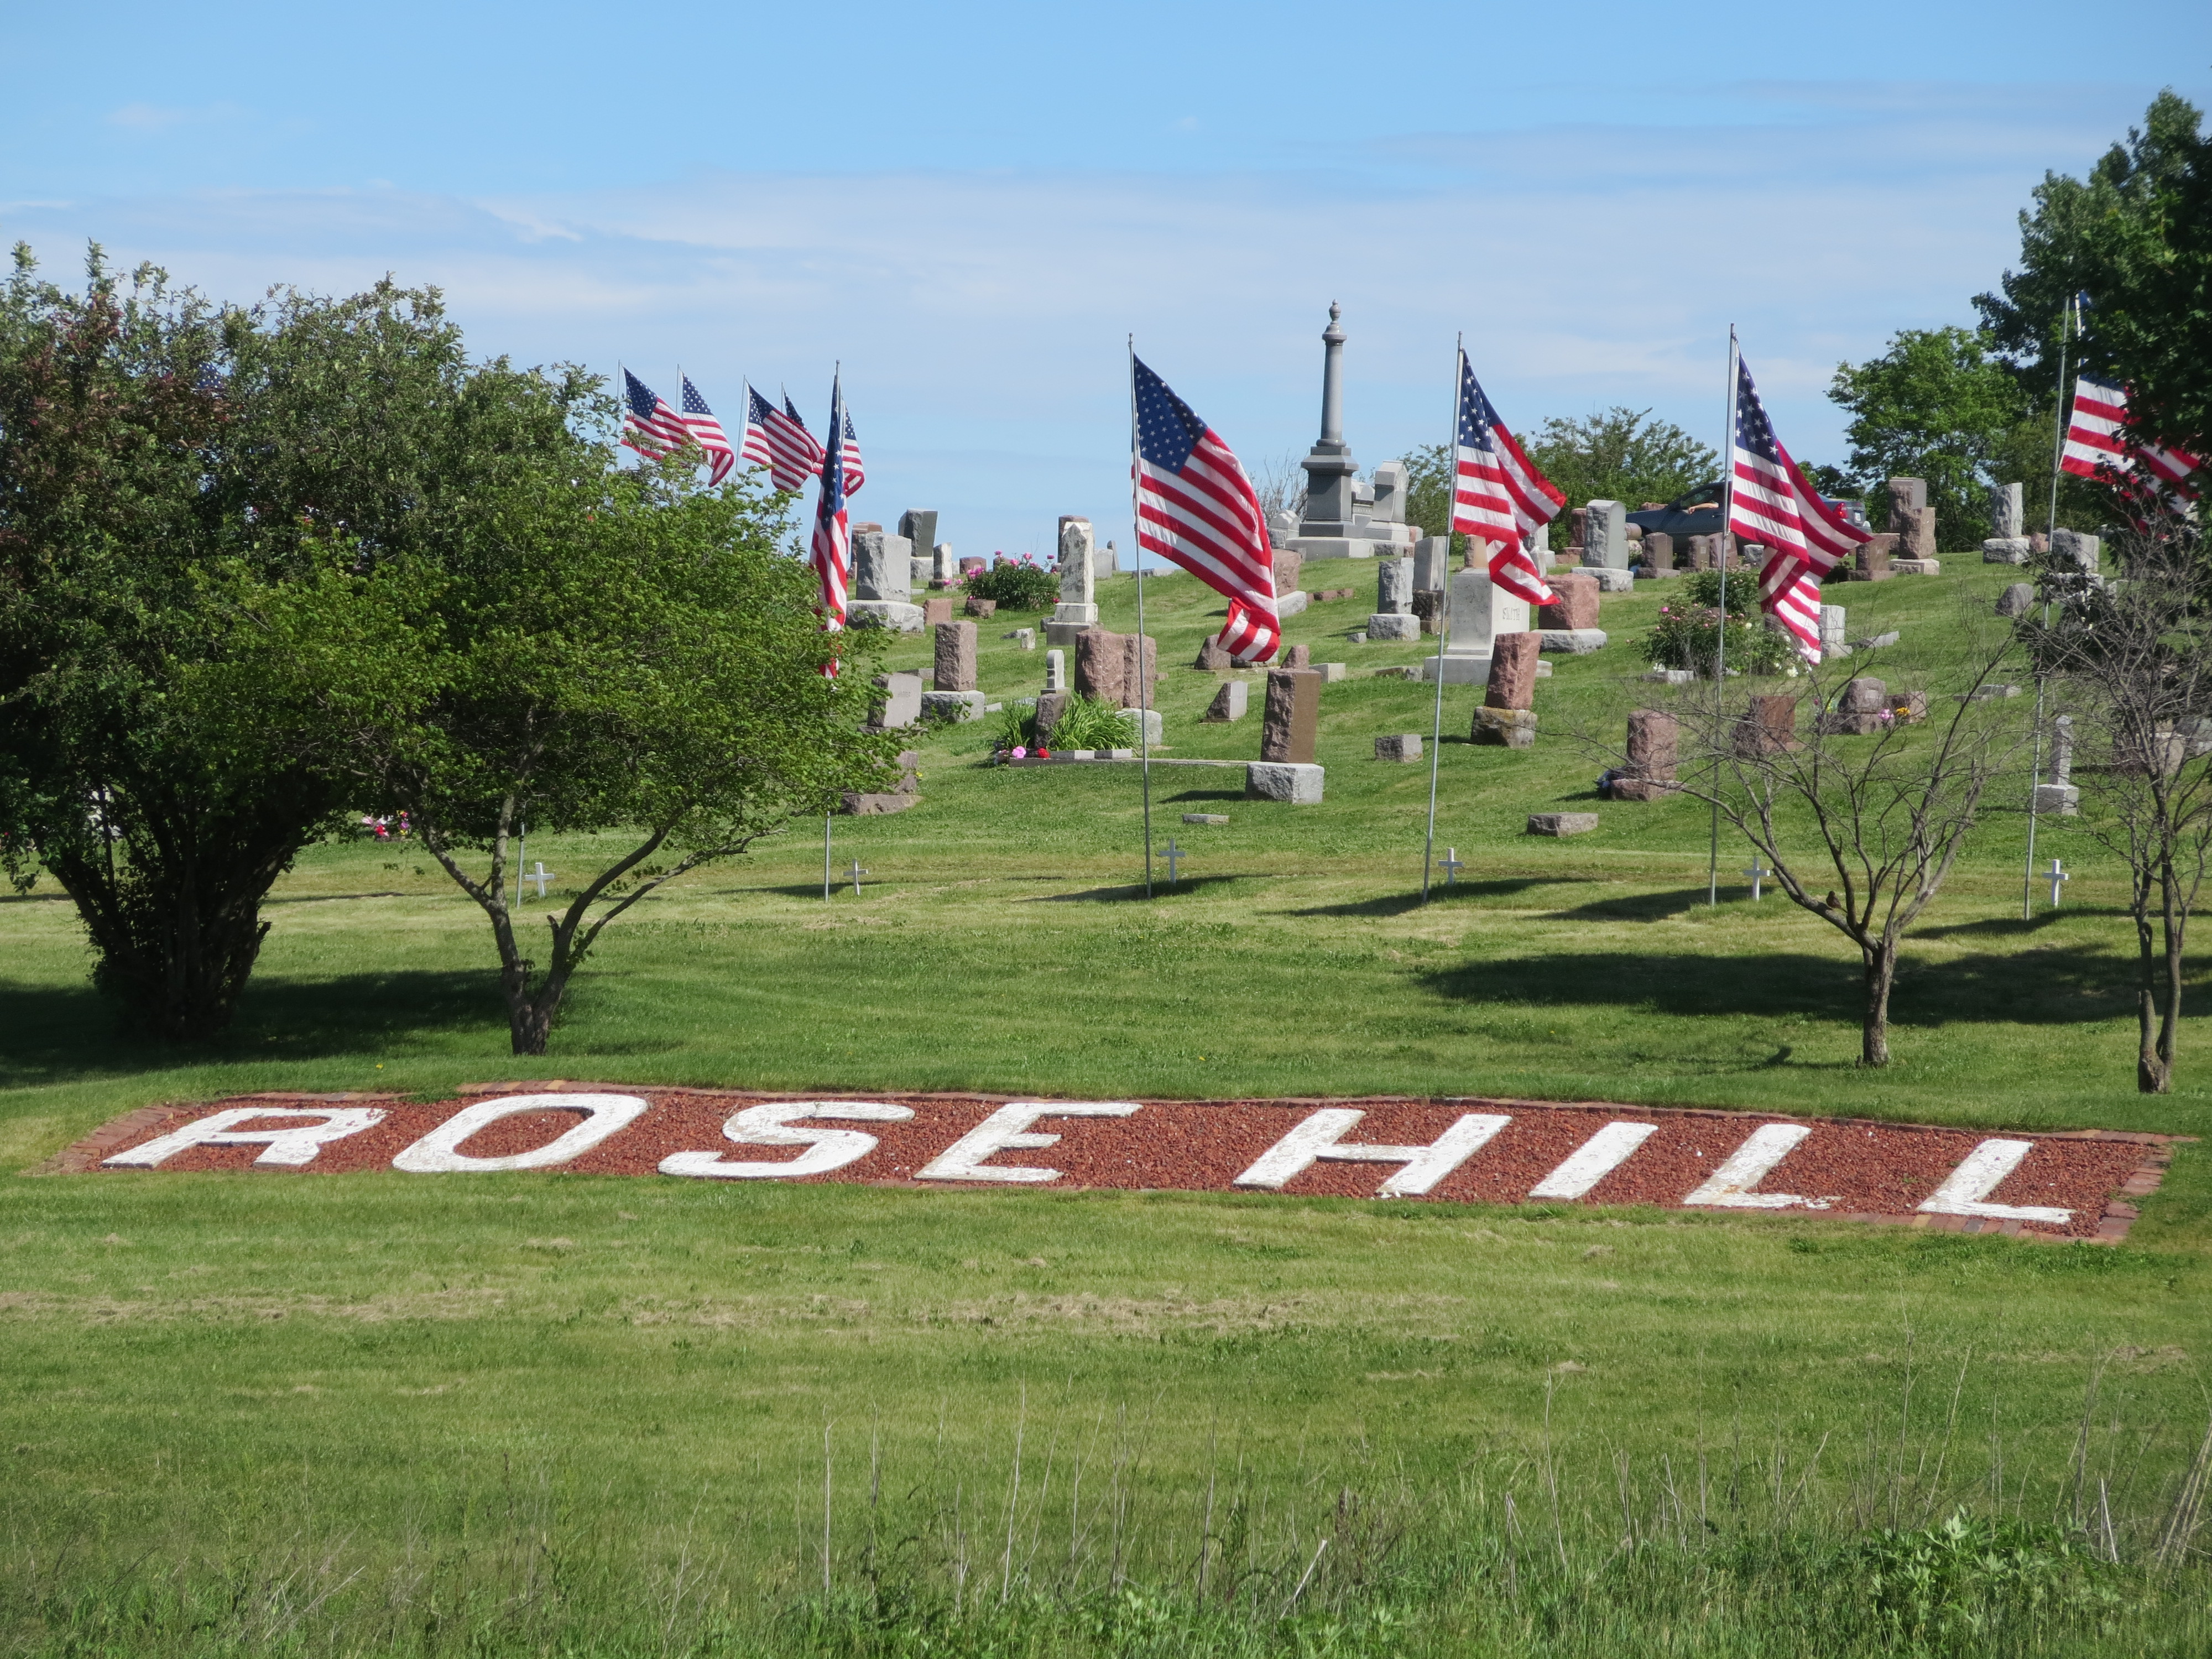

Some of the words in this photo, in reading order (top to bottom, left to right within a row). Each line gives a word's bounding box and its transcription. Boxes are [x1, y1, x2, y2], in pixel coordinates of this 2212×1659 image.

[1503, 607, 1520, 620] SMITH
[101, 1093, 1144, 1182] ROSE
[1233, 1109, 2075, 1223] HILL
